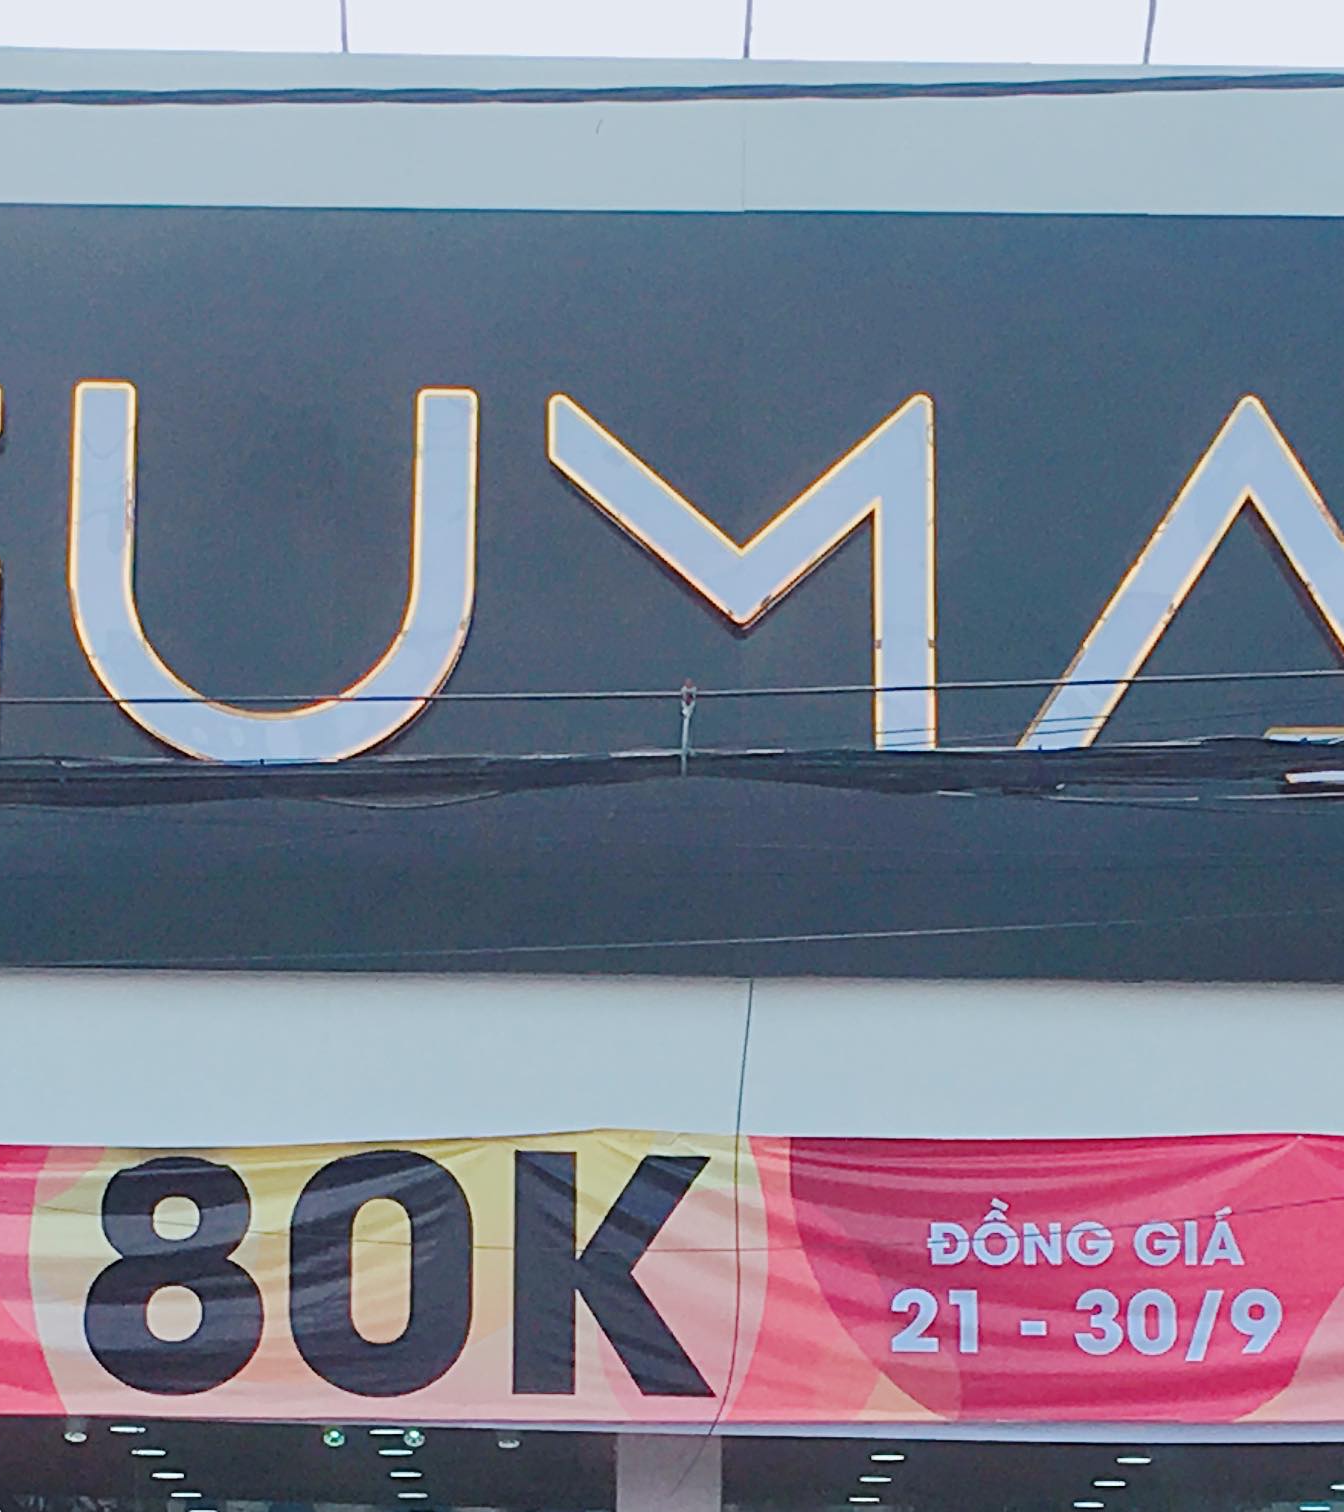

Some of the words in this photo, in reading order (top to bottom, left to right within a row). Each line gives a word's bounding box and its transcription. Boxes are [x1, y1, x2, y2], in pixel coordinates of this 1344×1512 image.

[928, 1197, 1113, 1267] ĐỒNG
[1133, 1205, 1244, 1268] GIÁ
[83, 1149, 716, 1398] 80K
[891, 1291, 980, 1353] 21
[1075, 1287, 1283, 1361] 30/9
